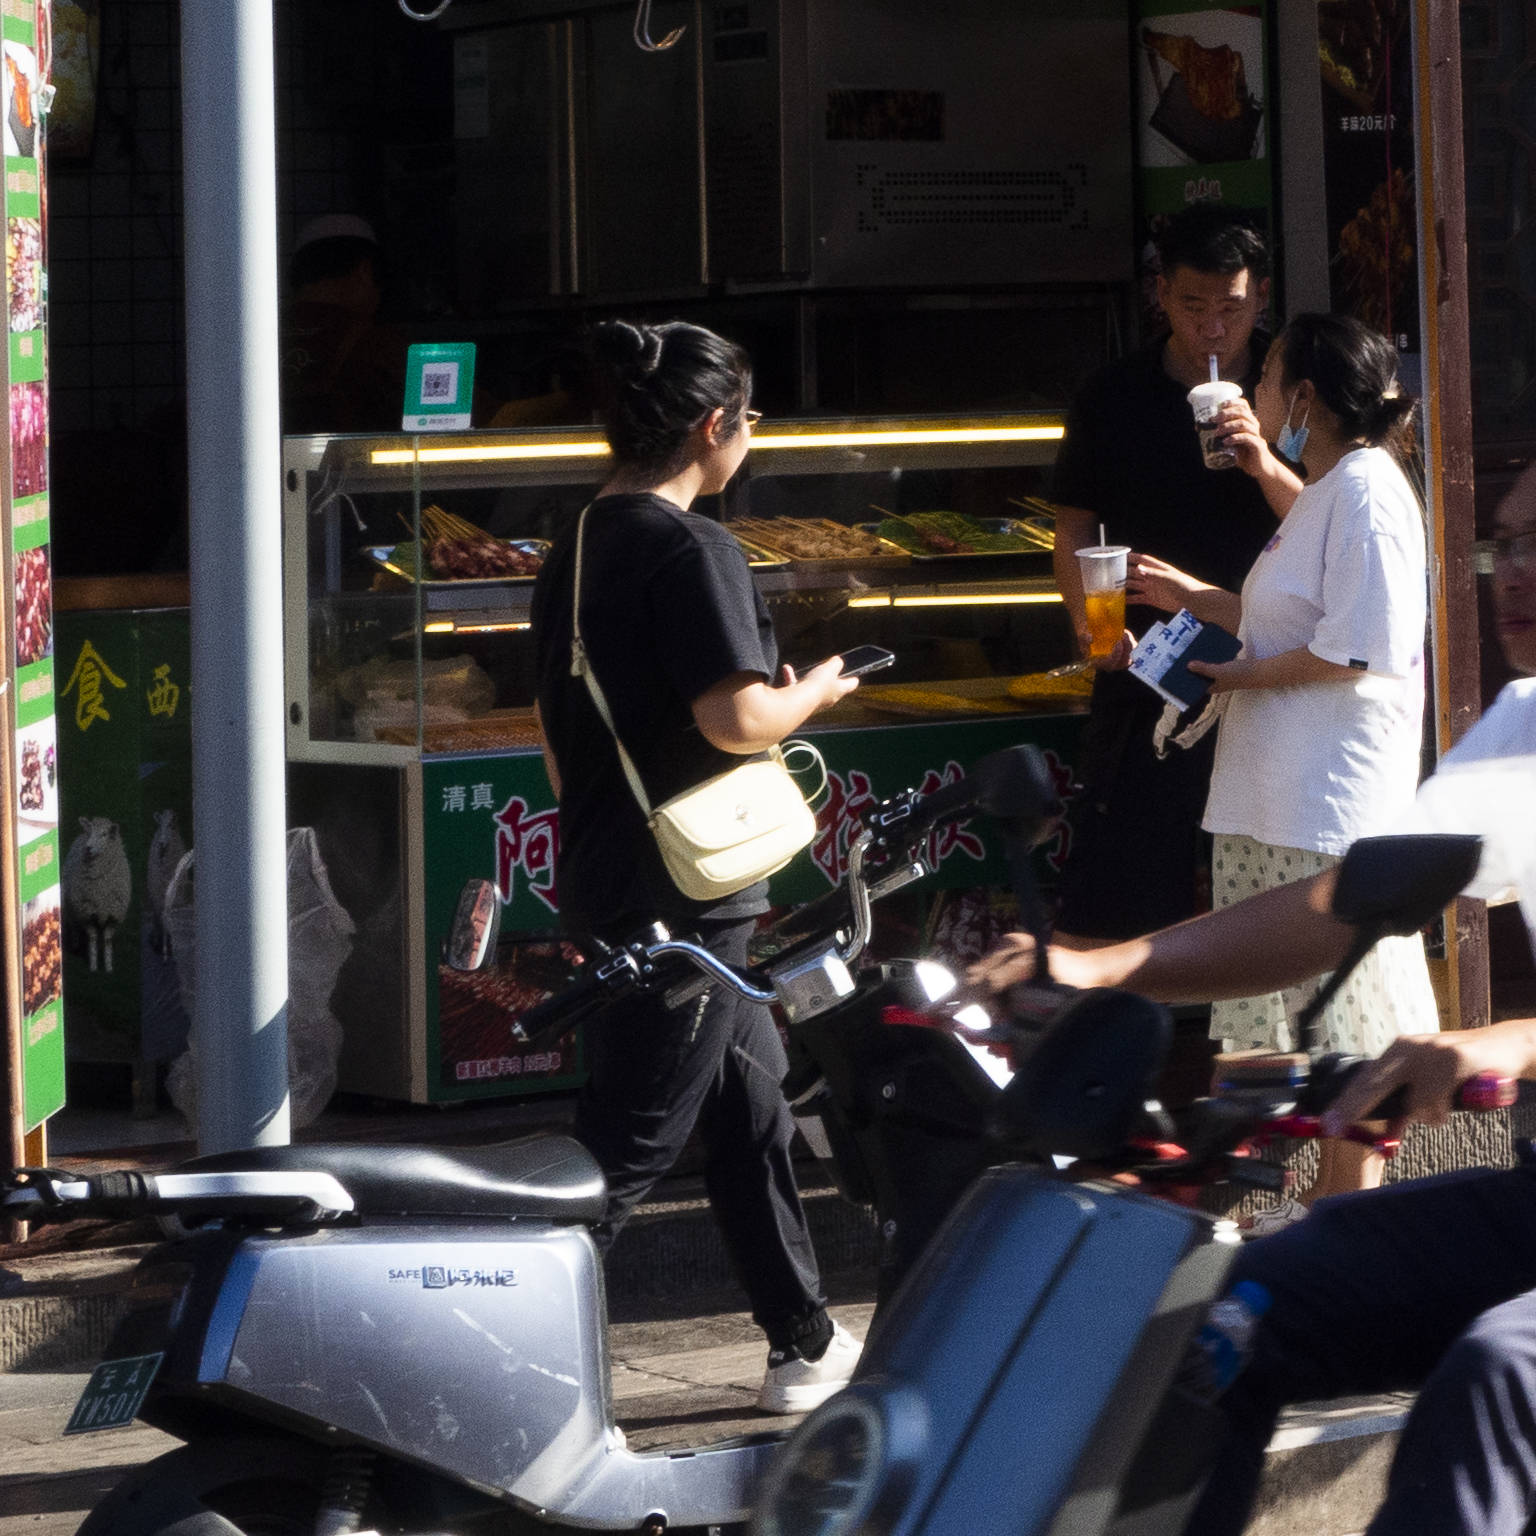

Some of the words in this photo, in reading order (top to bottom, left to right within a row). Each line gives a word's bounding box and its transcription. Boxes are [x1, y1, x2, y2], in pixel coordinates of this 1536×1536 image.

[60, 639, 128, 733] 食
[145, 665, 181, 718] 西
[442, 782, 496, 813] 清真
[388, 1267, 421, 1281] SAFE
